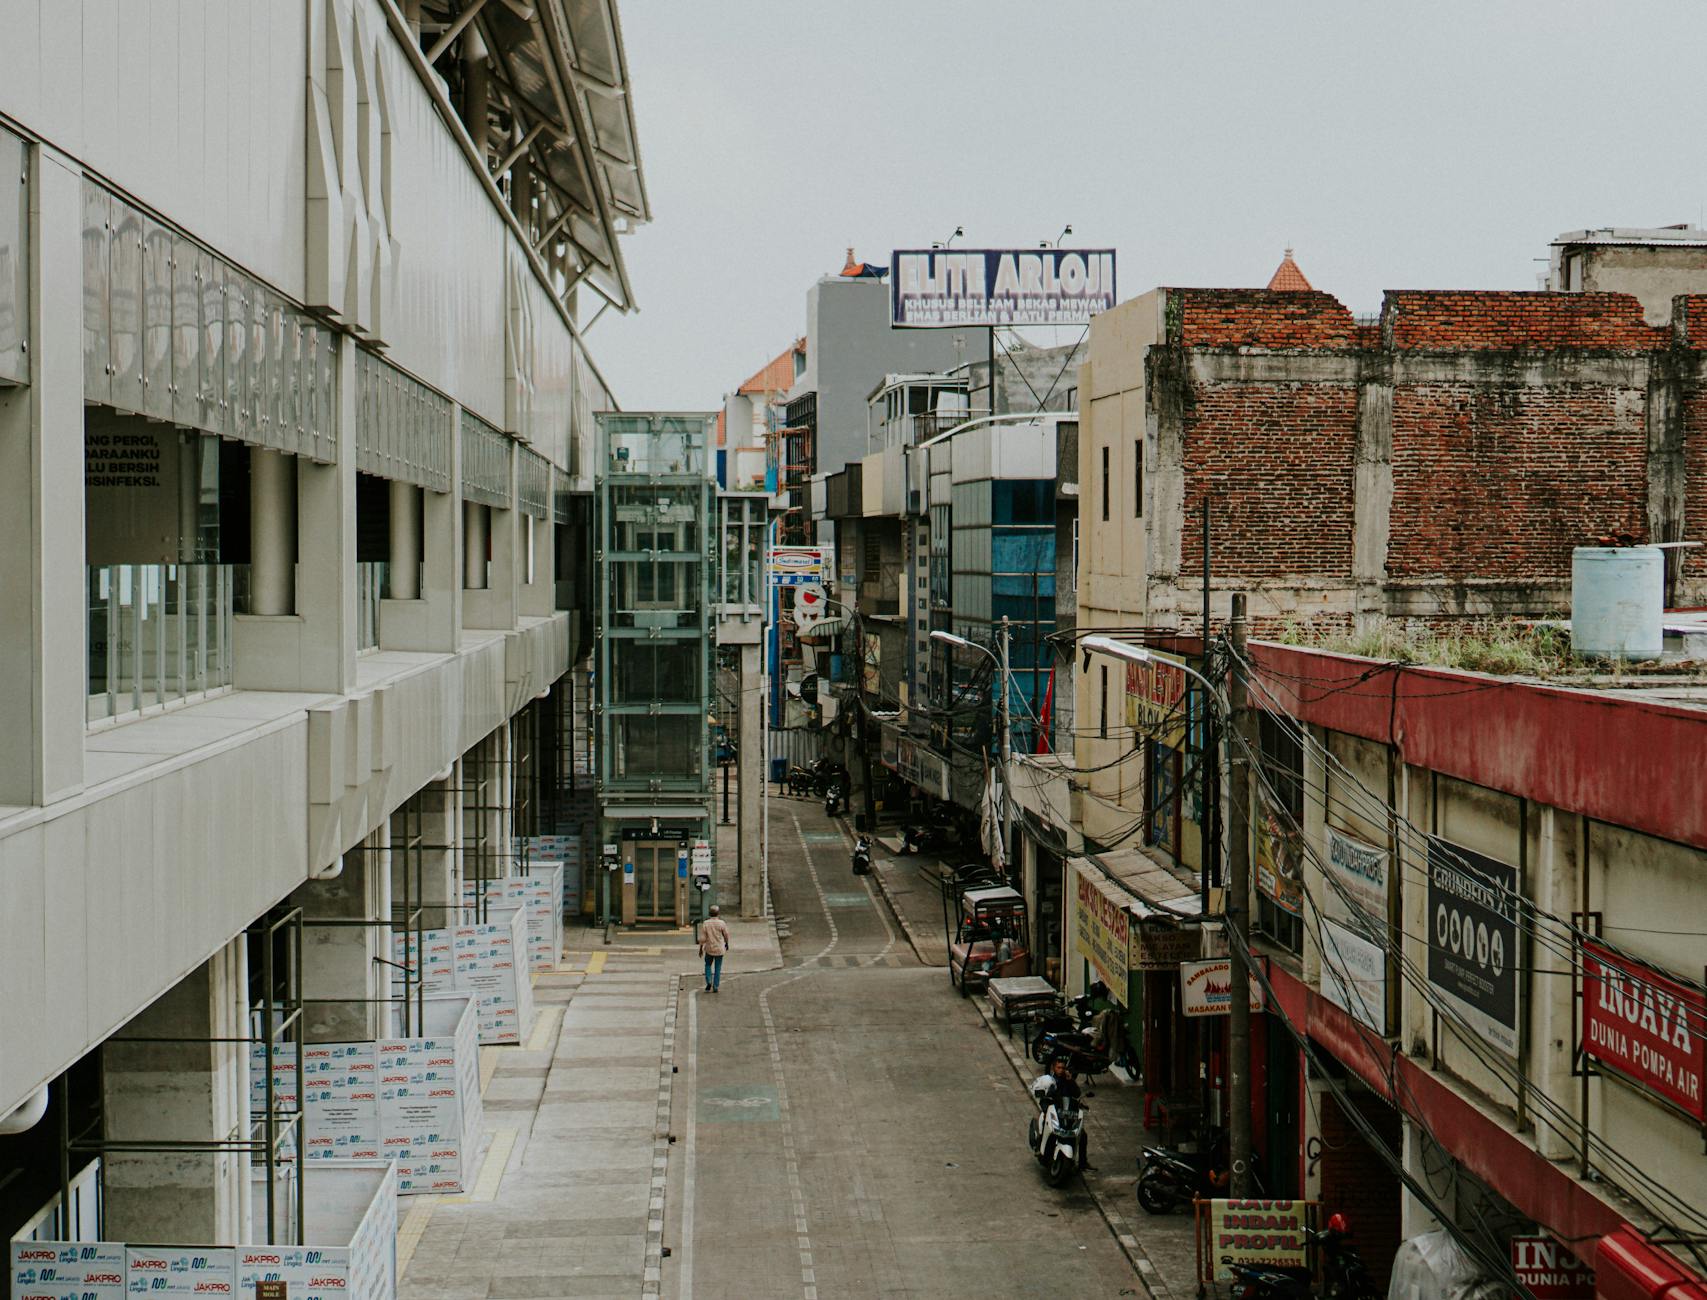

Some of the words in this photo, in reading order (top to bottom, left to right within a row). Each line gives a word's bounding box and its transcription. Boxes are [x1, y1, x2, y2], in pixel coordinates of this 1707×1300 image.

[899, 253, 986, 293] ELITE
[994, 253, 1113, 294] ARLOJI
[905, 298, 956, 310] KHUSUS
[988, 298, 1014, 310] JAM
[1018, 298, 1056, 310] BEKAS
[1060, 298, 1106, 310] MEWAH
[113, 435, 158, 448] PERGI,
[109, 462, 160, 473] BERSIH
[1434, 867, 1495, 911] GRUNDFOS
[1187, 964, 1229, 986] SAMBALADO
[1188, 1005, 1226, 1014] MASAKAN
[1600, 964, 1692, 1054] INJAYA
[1590, 1018, 1628, 1058] DUNIA
[1633, 1040, 1674, 1086] POMPA
[1678, 1067, 1698, 1101] AIR
[1224, 1214, 1298, 1230] INDAH
[1219, 1234, 1304, 1250] PROFIL
[18, 1250, 56, 1260] JAKPRO
[242, 1255, 280, 1263] JAKPRO
[131, 1260, 167, 1269] JAKPRO
[84, 1274, 121, 1283] JAKPRO
[308, 1278, 346, 1287] JAKPRO
[1516, 1273, 1570, 1286] DUNIA
[194, 1283, 230, 1292] JAKPRO
